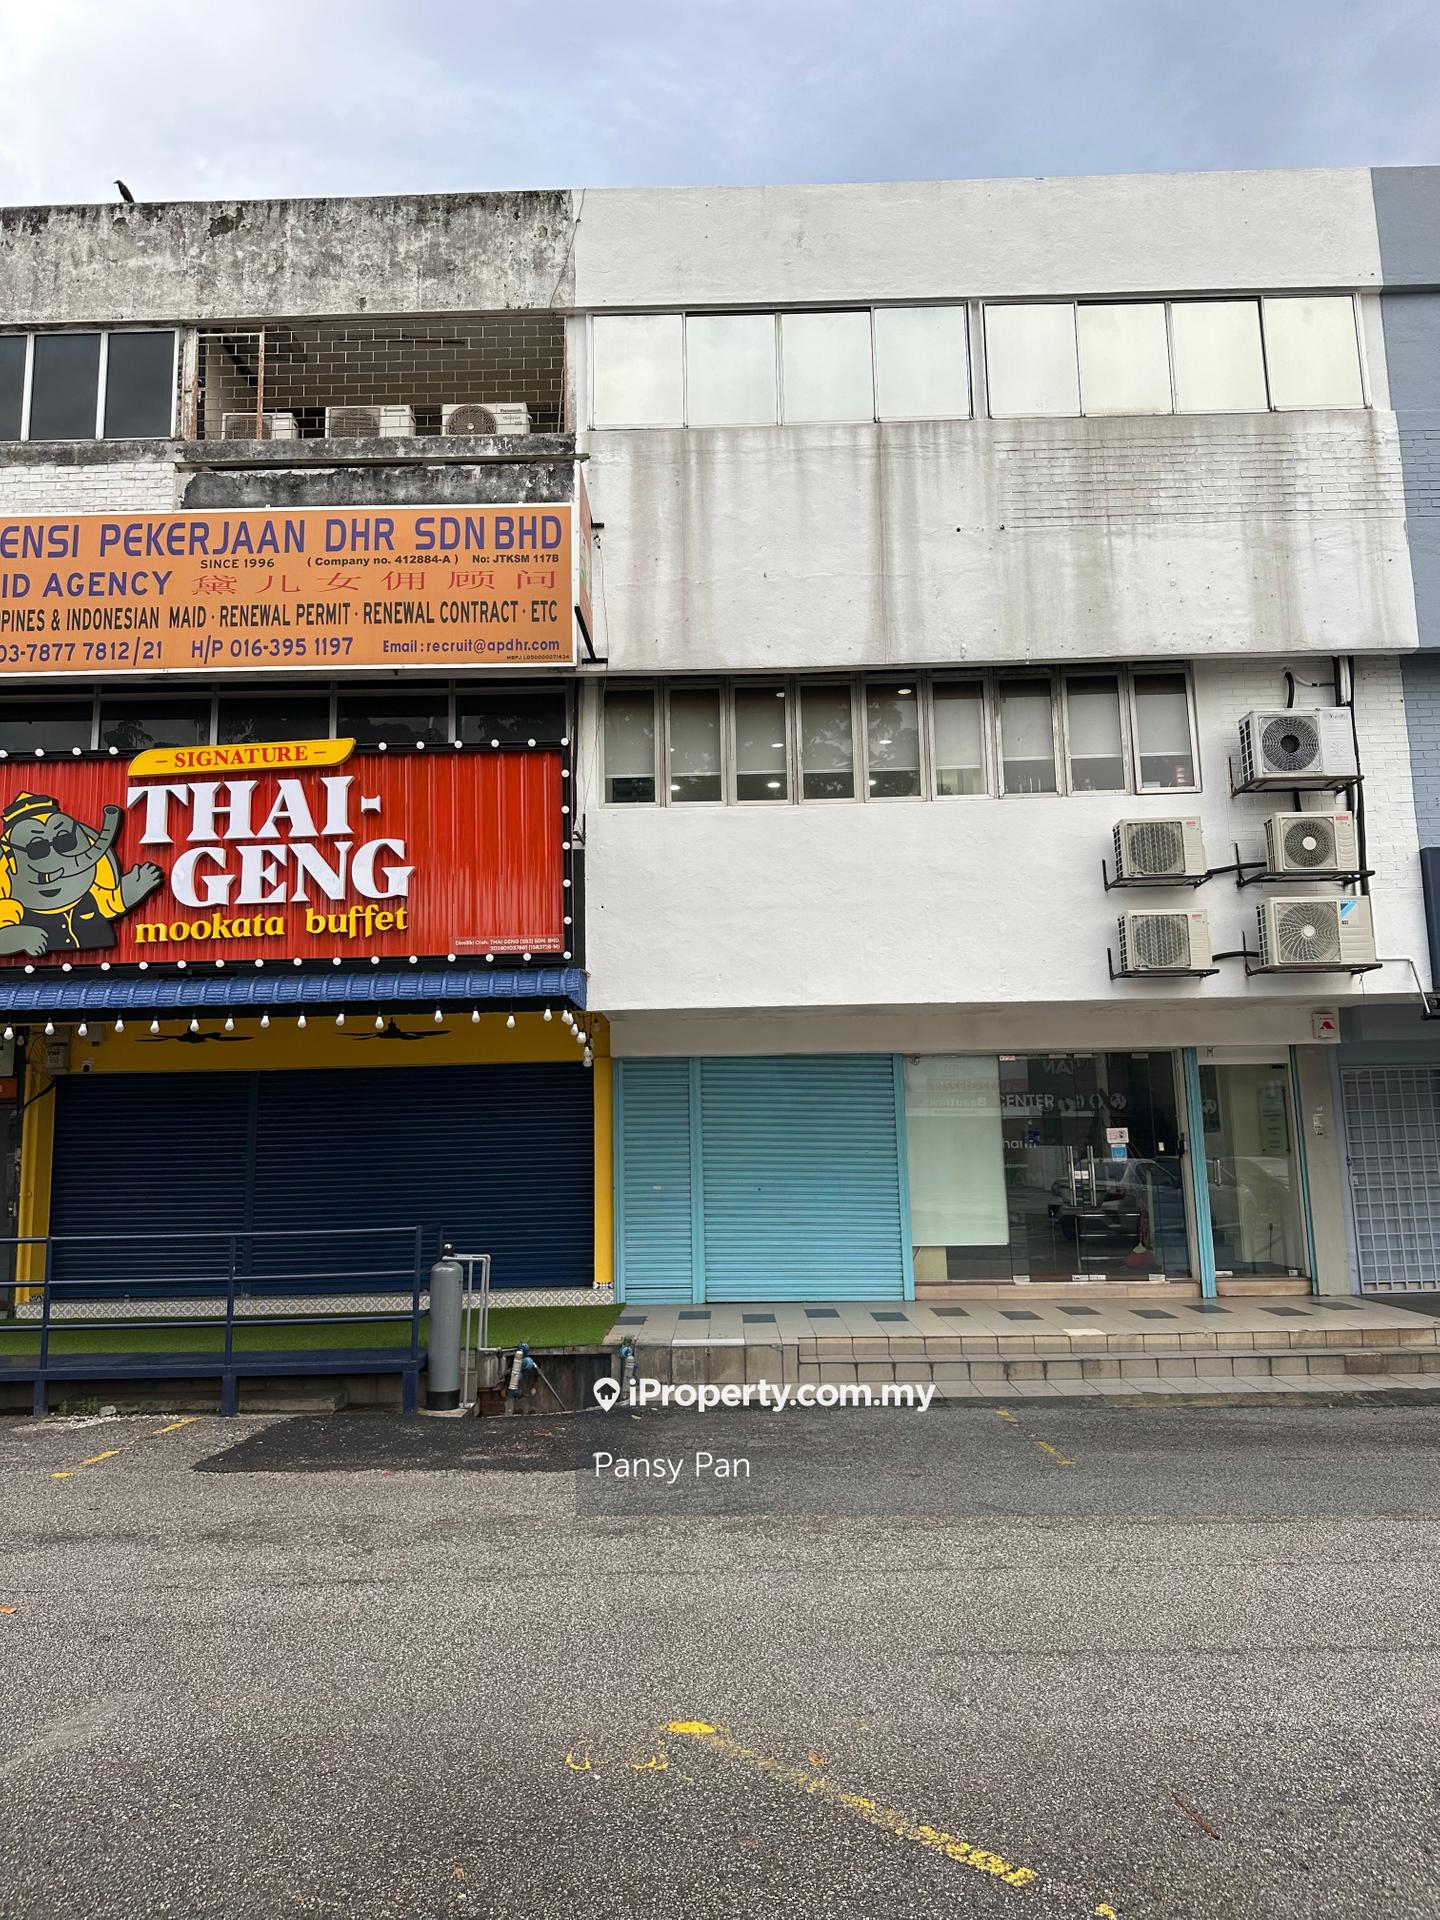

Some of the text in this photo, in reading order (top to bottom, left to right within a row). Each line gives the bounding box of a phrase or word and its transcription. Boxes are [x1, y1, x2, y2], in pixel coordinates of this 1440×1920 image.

[0, 515, 562, 559] ENSI PEKERJAAN DHR SDN BHD
[200, 558, 275, 569] SINCE 1996
[373, 557, 391, 565] no.
[472, 554, 559, 564] No: JTKSM 117B
[2, 571, 173, 598] ID AGENCY
[0, 600, 558, 632] PINES & INDONESIAN MAID RENEWAL PERMIT RENEWAL CONTRACT ETC
[83, 636, 162, 666] 7812/21
[192, 635, 353, 664] H/P 016-395 1197
[174, 745, 308, 768] SIGNATURE
[127, 775, 381, 845] THAI-
[170, 838, 416, 908] GENG
[135, 904, 409, 944] mookata buffet
